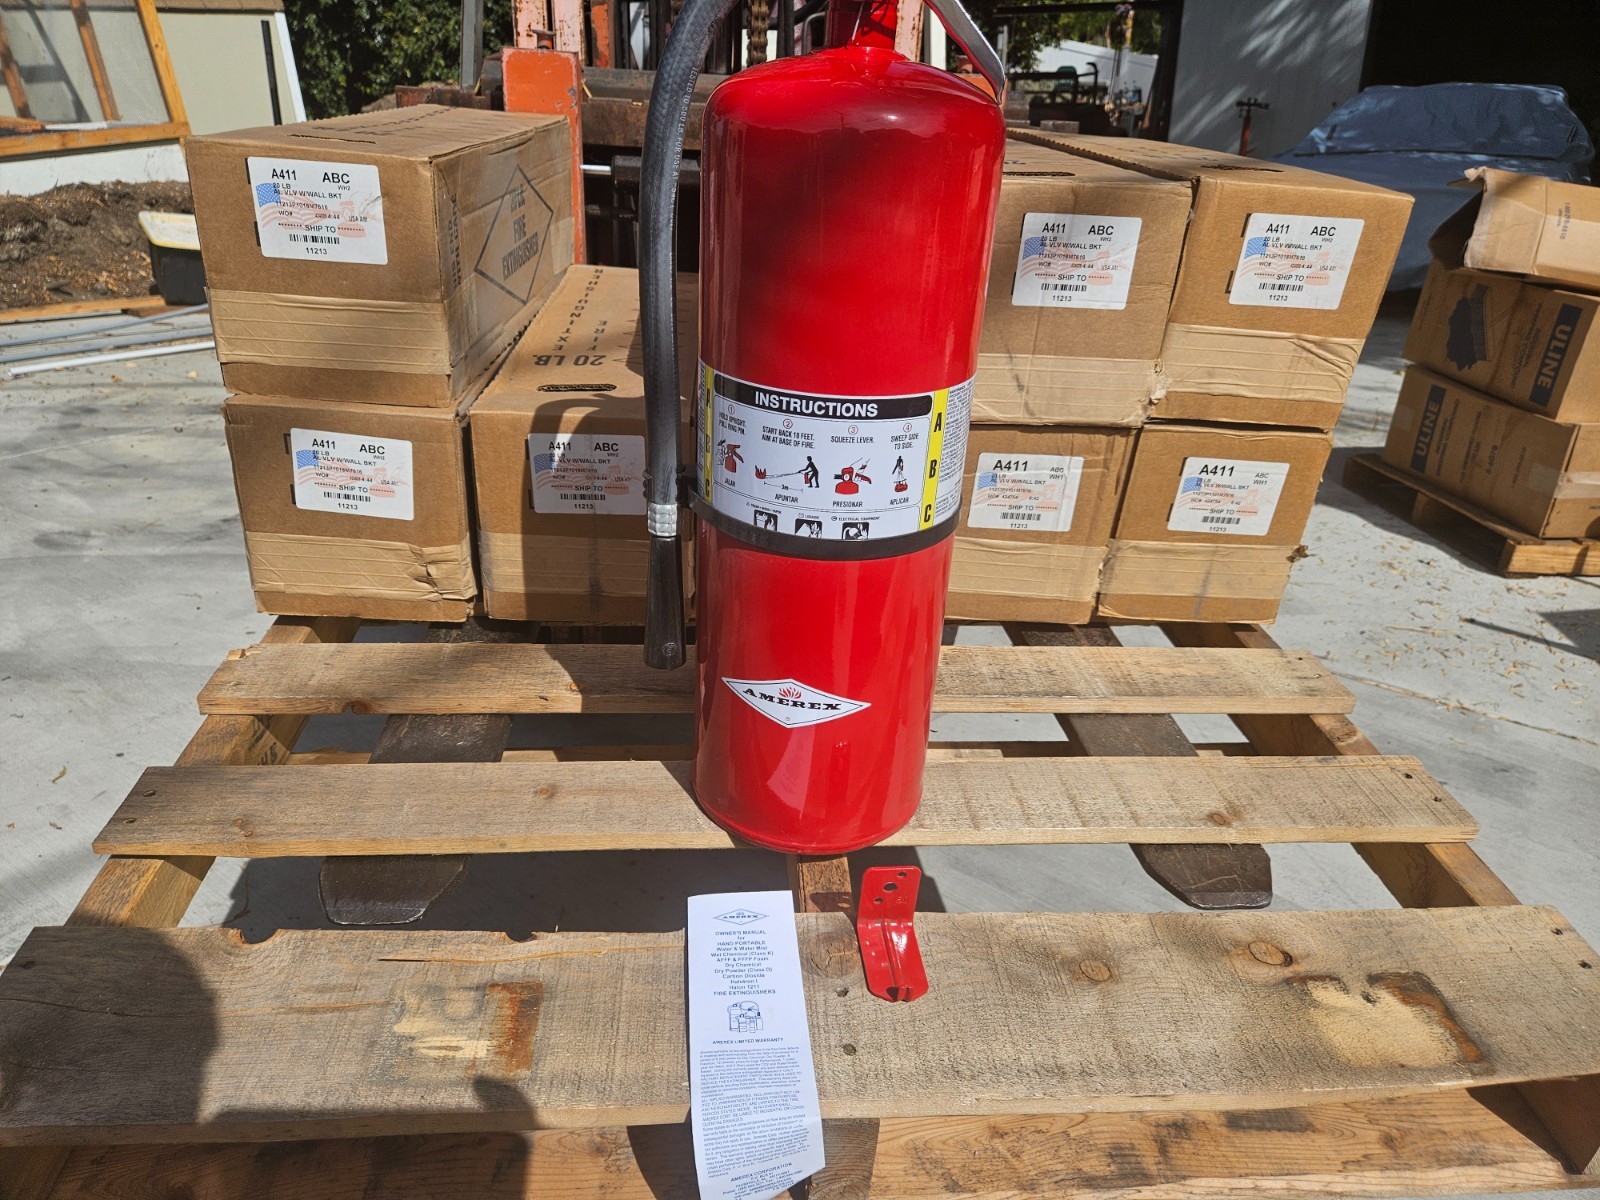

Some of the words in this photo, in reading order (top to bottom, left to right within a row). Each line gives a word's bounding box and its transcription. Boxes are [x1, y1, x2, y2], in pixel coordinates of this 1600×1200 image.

[686, 66, 698, 92] TESTED
[683, 94, 691, 104] TO
[674, 137, 683, 152] FOR
[673, 154, 681, 170] USE
[272, 168, 296, 180] A411
[322, 172, 350, 184] ABC
[672, 171, 679, 181] AT
[1042, 223, 1066, 233] A411
[1088, 225, 1114, 235] ABC
[1266, 224, 1290, 234] A411
[1311, 226, 1336, 236] ABC
[534, 354, 567, 366] LB.
[573, 355, 606, 365] 20
[1538, 324, 1572, 390] ULINE
[755, 391, 878, 417] INSTRUCTIONS
[719, 412, 728, 420] HOLD
[934, 412, 942, 432] A
[719, 420, 727, 429] PULL
[728, 423, 737, 433] RING
[763, 426, 778, 434] START
[779, 428, 791, 437] BACK
[801, 432, 814, 440] FEET.
[1416, 401, 1440, 456] ULINE
[312, 439, 335, 449] A411
[360, 444, 385, 455] ABC
[549, 442, 572, 450] A411
[594, 442, 618, 452] ABC
[779, 437, 792, 446] BASE
[929, 460, 937, 478] B
[993, 460, 1028, 471] A411
[1199, 464, 1235, 477] A411
[725, 478, 735, 487] JALAR
[775, 494, 798, 503] APUNTAR
[890, 497, 909, 505] APLICAR
[924, 504, 931, 522] C
[743, 688, 842, 710] AMEREX
